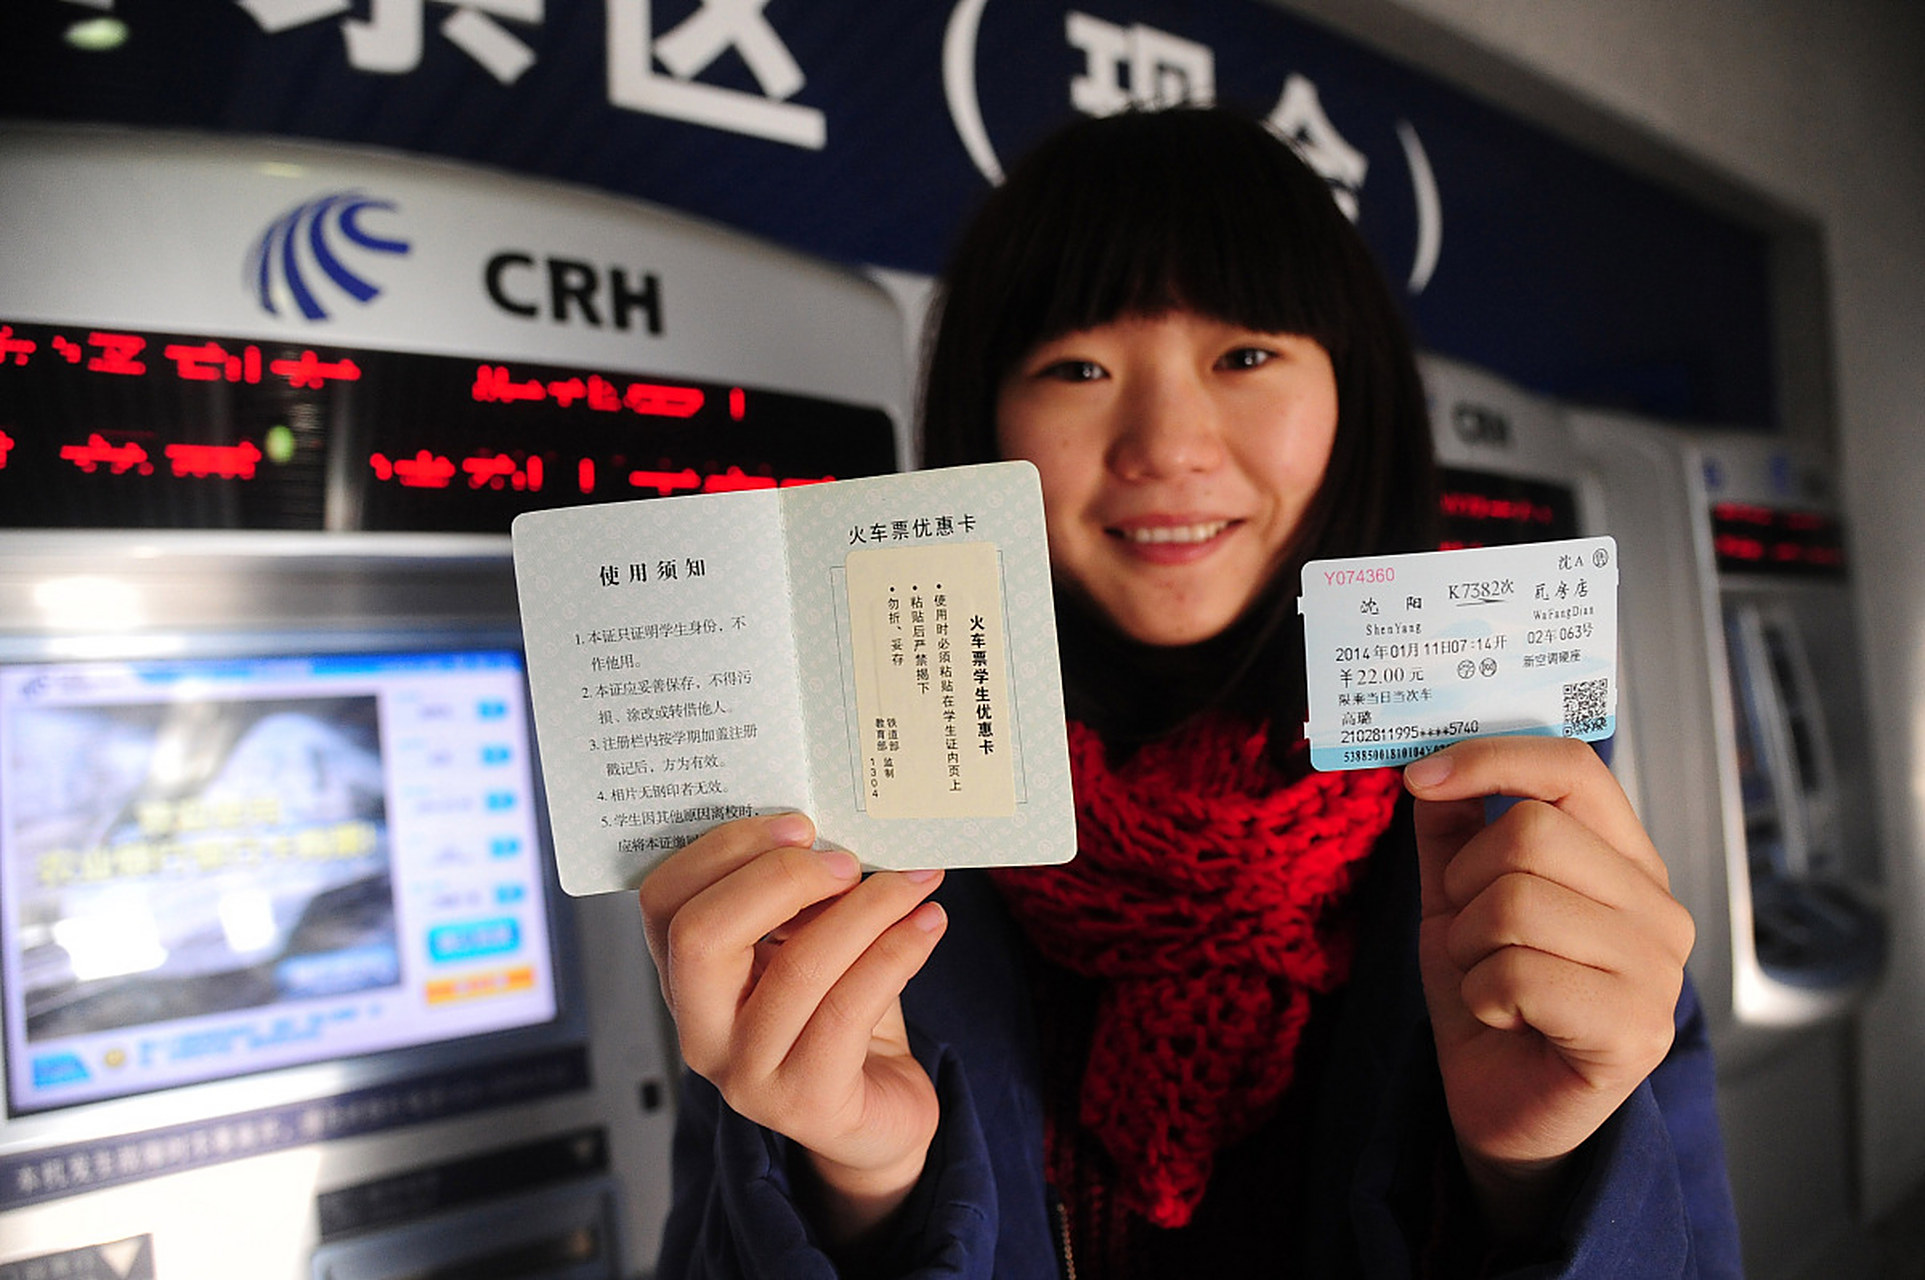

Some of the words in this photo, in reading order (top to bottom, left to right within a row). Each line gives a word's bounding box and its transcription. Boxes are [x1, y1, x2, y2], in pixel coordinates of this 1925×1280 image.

[484, 250, 665, 338] CRH
[849, 514, 976, 545] 火车票优惠卡
[599, 557, 707, 587] 使用须知
[1324, 567, 1396, 587] Y074360
[1448, 578, 1515, 600] K7382次
[1534, 577, 1590, 601] 瓦房店
[1360, 595, 1423, 616] 沈阳
[1366, 622, 1422, 637] ShenYang
[910, 595, 930, 695] 粘贴后严禁揭下
[934, 594, 962, 793] 使用时必须粘贴在学生证内页上
[969, 614, 994, 755] 火车票学生优惠卡
[1338, 687, 1433, 707] 限乘当日当次车
[869, 757, 880, 799] 1304
